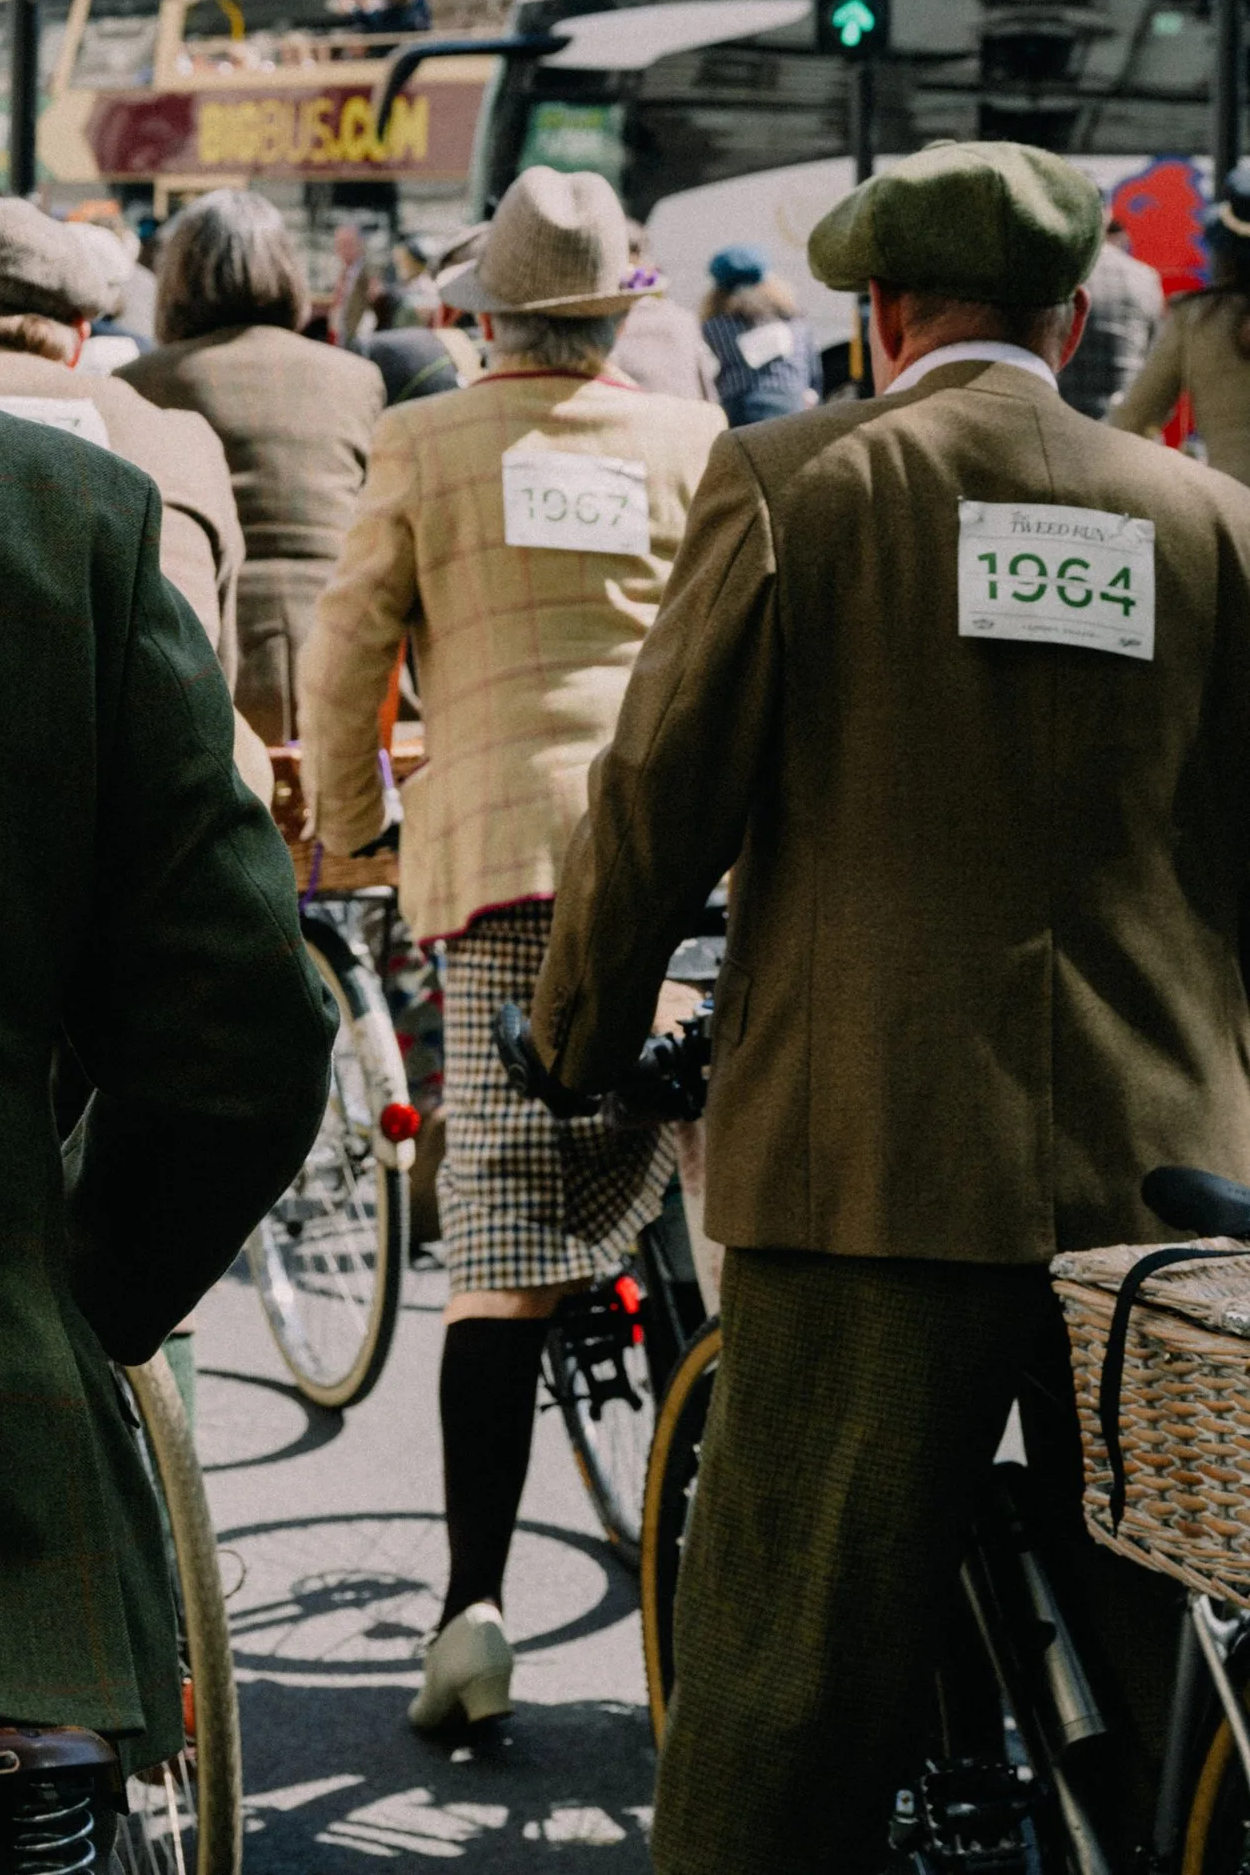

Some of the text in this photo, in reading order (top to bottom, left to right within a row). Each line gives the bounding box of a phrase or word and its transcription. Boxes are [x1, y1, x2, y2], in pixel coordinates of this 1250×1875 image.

[520, 488, 630, 527] 1967
[1010, 520, 1071, 536] TWEED
[977, 552, 1137, 617] 1964
